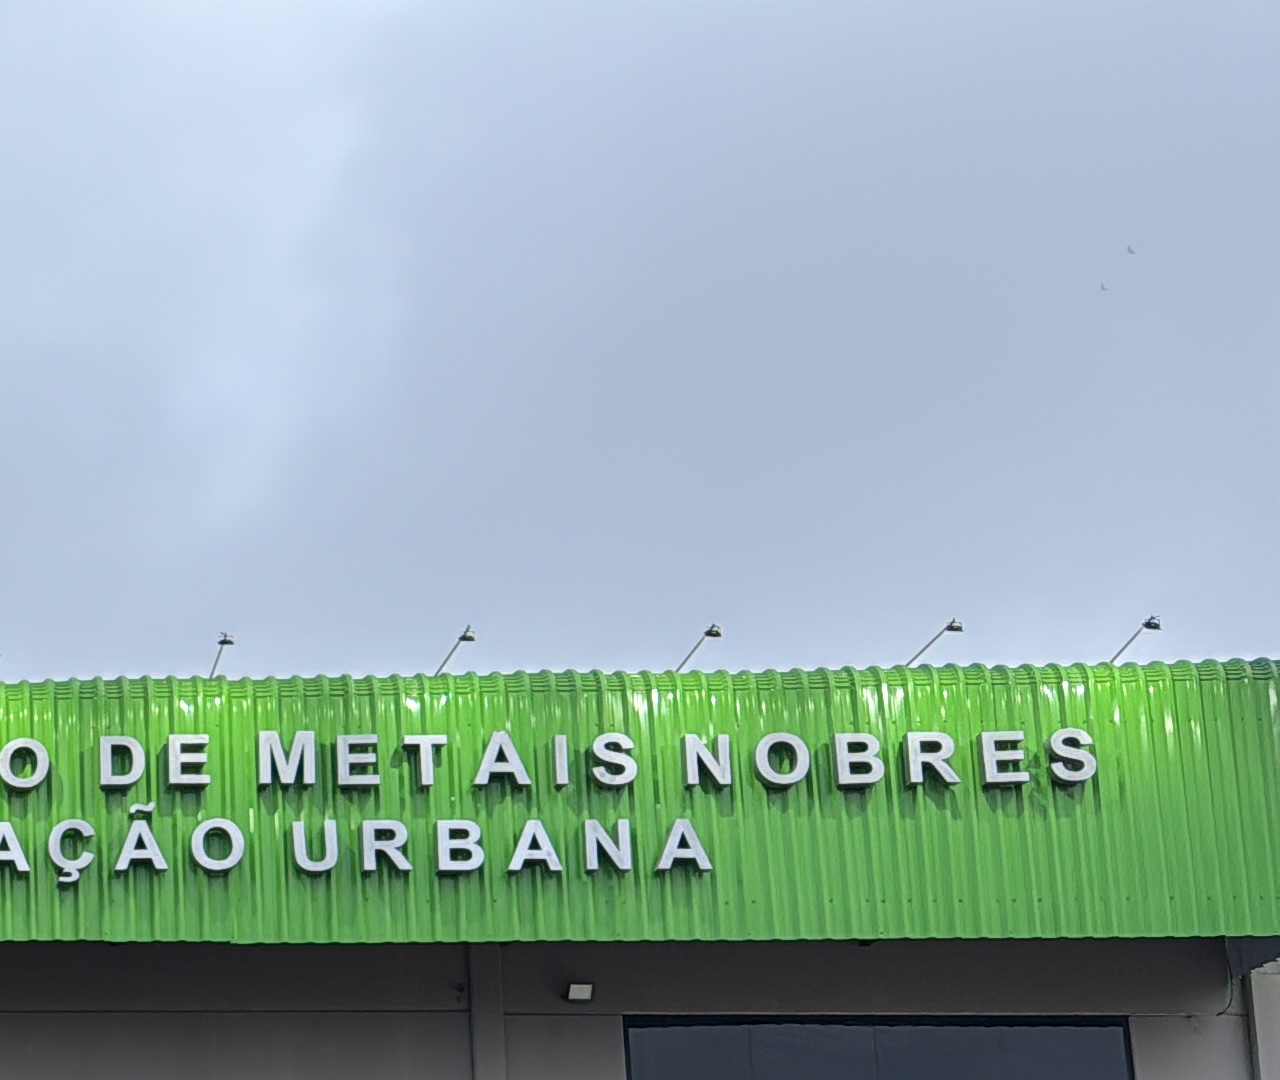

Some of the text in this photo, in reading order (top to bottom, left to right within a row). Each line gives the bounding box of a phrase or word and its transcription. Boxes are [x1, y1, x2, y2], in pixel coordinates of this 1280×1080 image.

[98, 733, 213, 788] DE
[257, 729, 638, 787] METAIS
[683, 727, 1099, 786] NOBRES
[291, 817, 715, 874] URBANA
